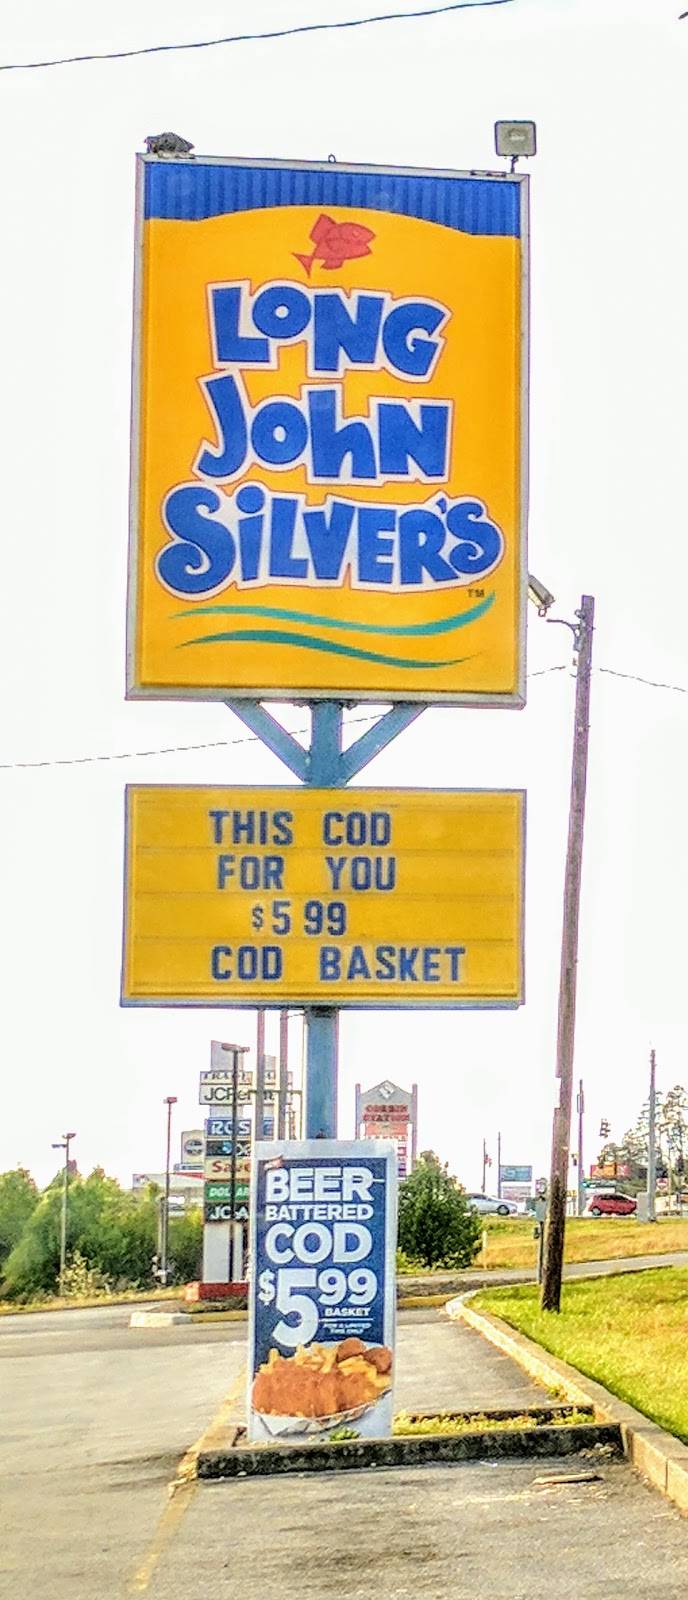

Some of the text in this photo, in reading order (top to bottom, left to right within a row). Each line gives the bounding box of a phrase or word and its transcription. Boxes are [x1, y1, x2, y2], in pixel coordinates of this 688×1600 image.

[209, 284, 447, 378] LONG
[209, 810, 392, 847] THIS COD
[216, 855, 397, 891] FOR YOU
[210, 945, 467, 982] COD BASKET
[208, 1187, 250, 1197] DOLAR
[265, 1203, 375, 1221] BATTERED
[265, 1222, 373, 1264] COD
[324, 1307, 371, 1316] BASKET
